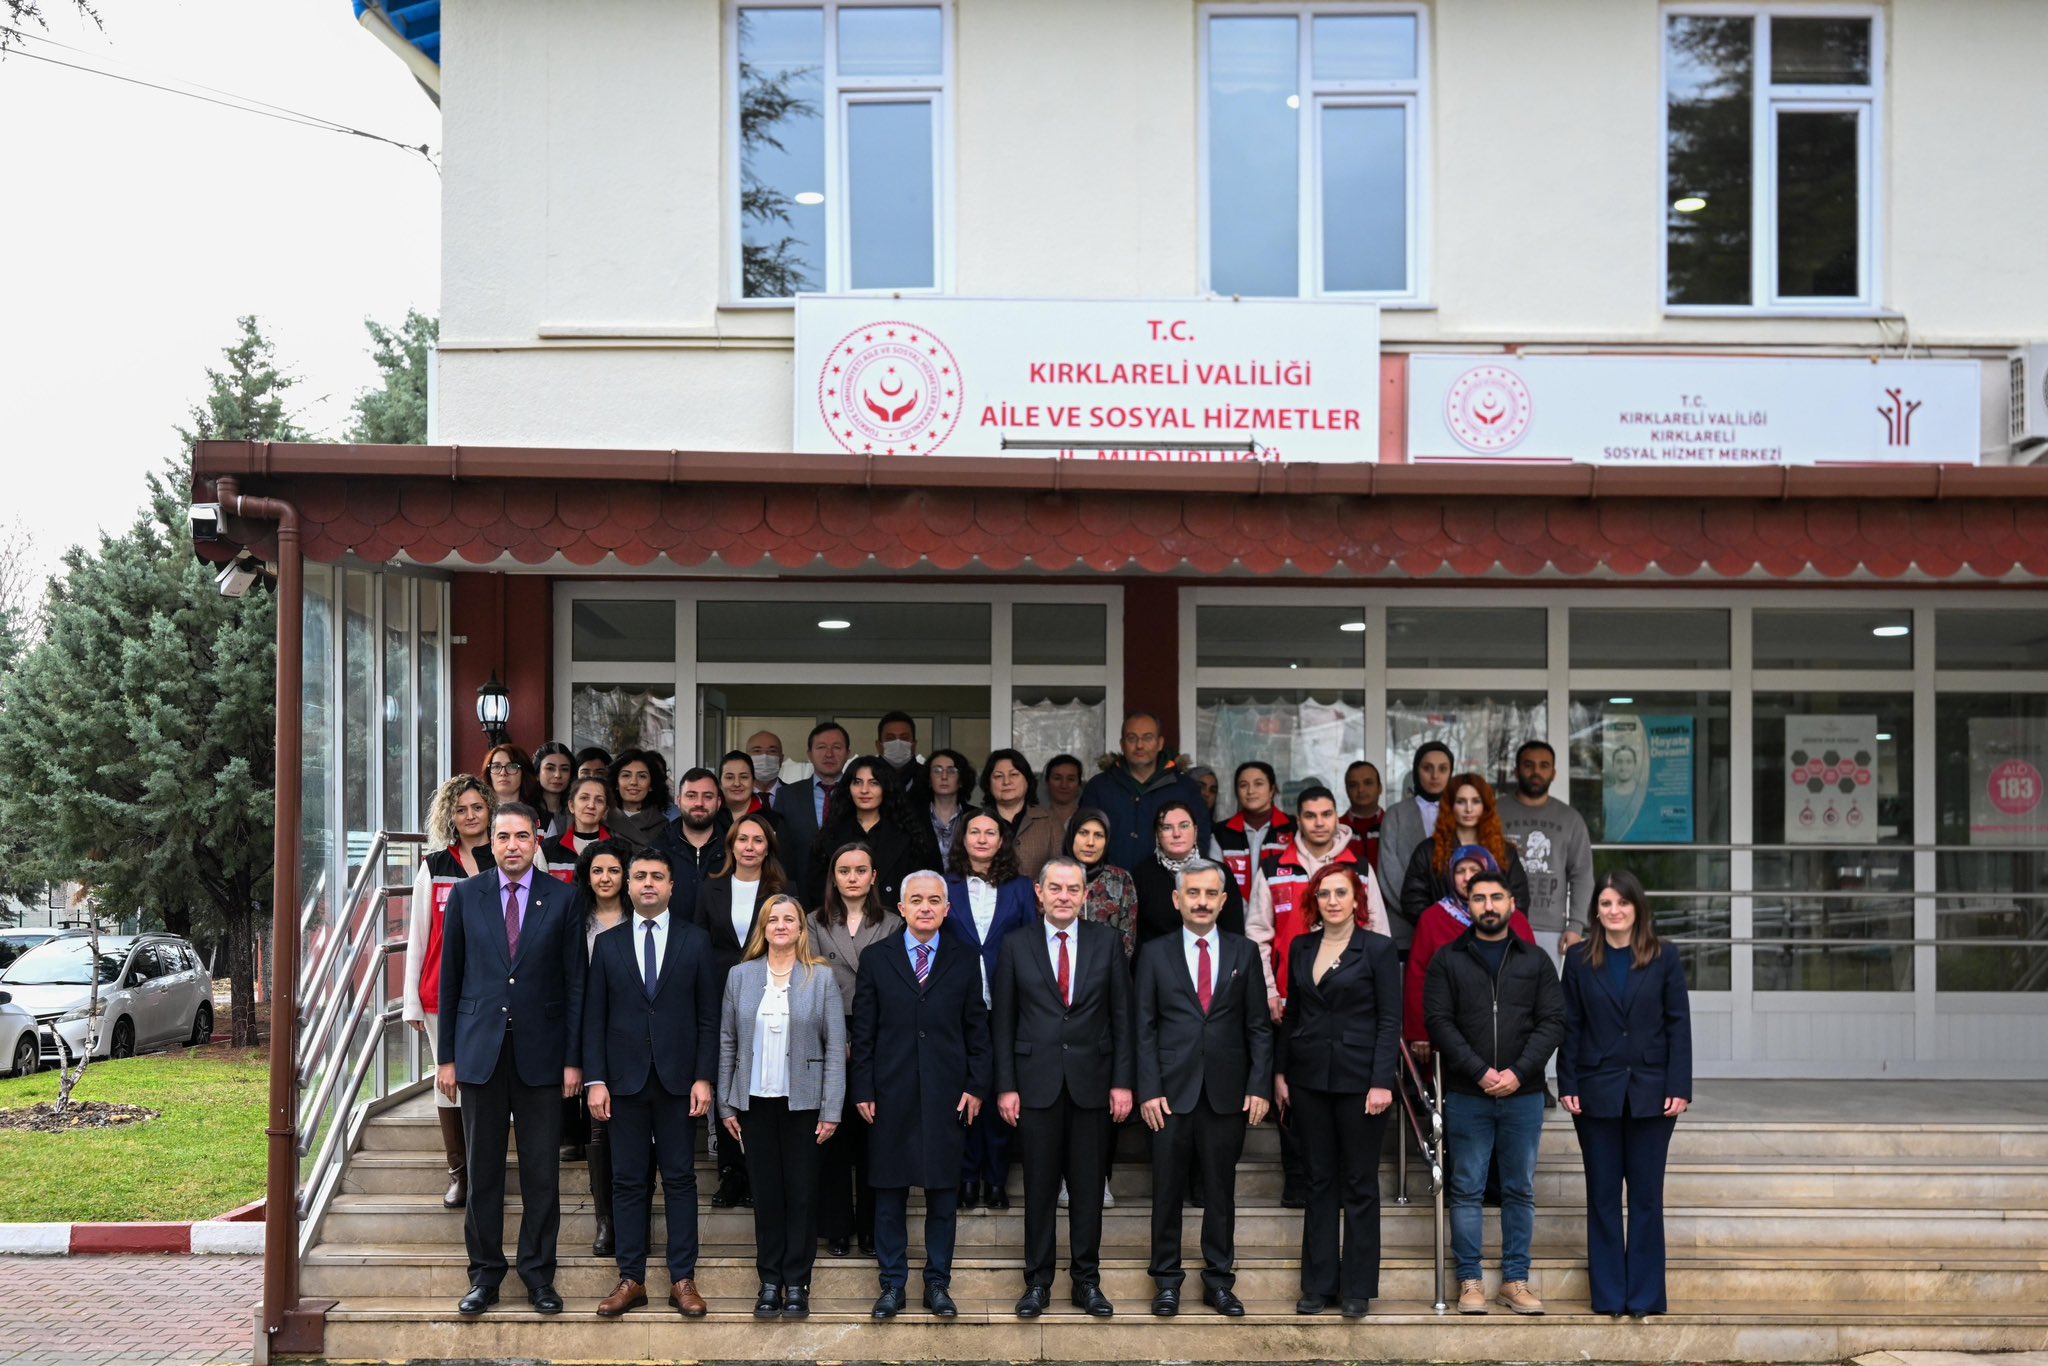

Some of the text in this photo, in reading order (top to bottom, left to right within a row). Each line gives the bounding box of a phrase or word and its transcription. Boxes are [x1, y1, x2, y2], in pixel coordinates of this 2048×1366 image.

[1147, 320, 1195, 342] T.C.
[1029, 359, 1312, 386] KIRKLARELİ VALİLİĞİ
[1680, 394, 1707, 408] T.C.
[980, 401, 1360, 430] AİLE VE SOSYAL HİZMETLER
[1619, 410, 1767, 426] KIRKLARELİ VALİLİĞİ
[1650, 429, 1736, 443] KIRKLARELİ
[1603, 444, 1782, 461] SOSYAL HİZMET MERKEZİ
[1650, 736, 1690, 748] Hayata
[1650, 746, 1689, 757] Devam!
[2003, 764, 2028, 776] ALO
[1997, 777, 2034, 799] 183
